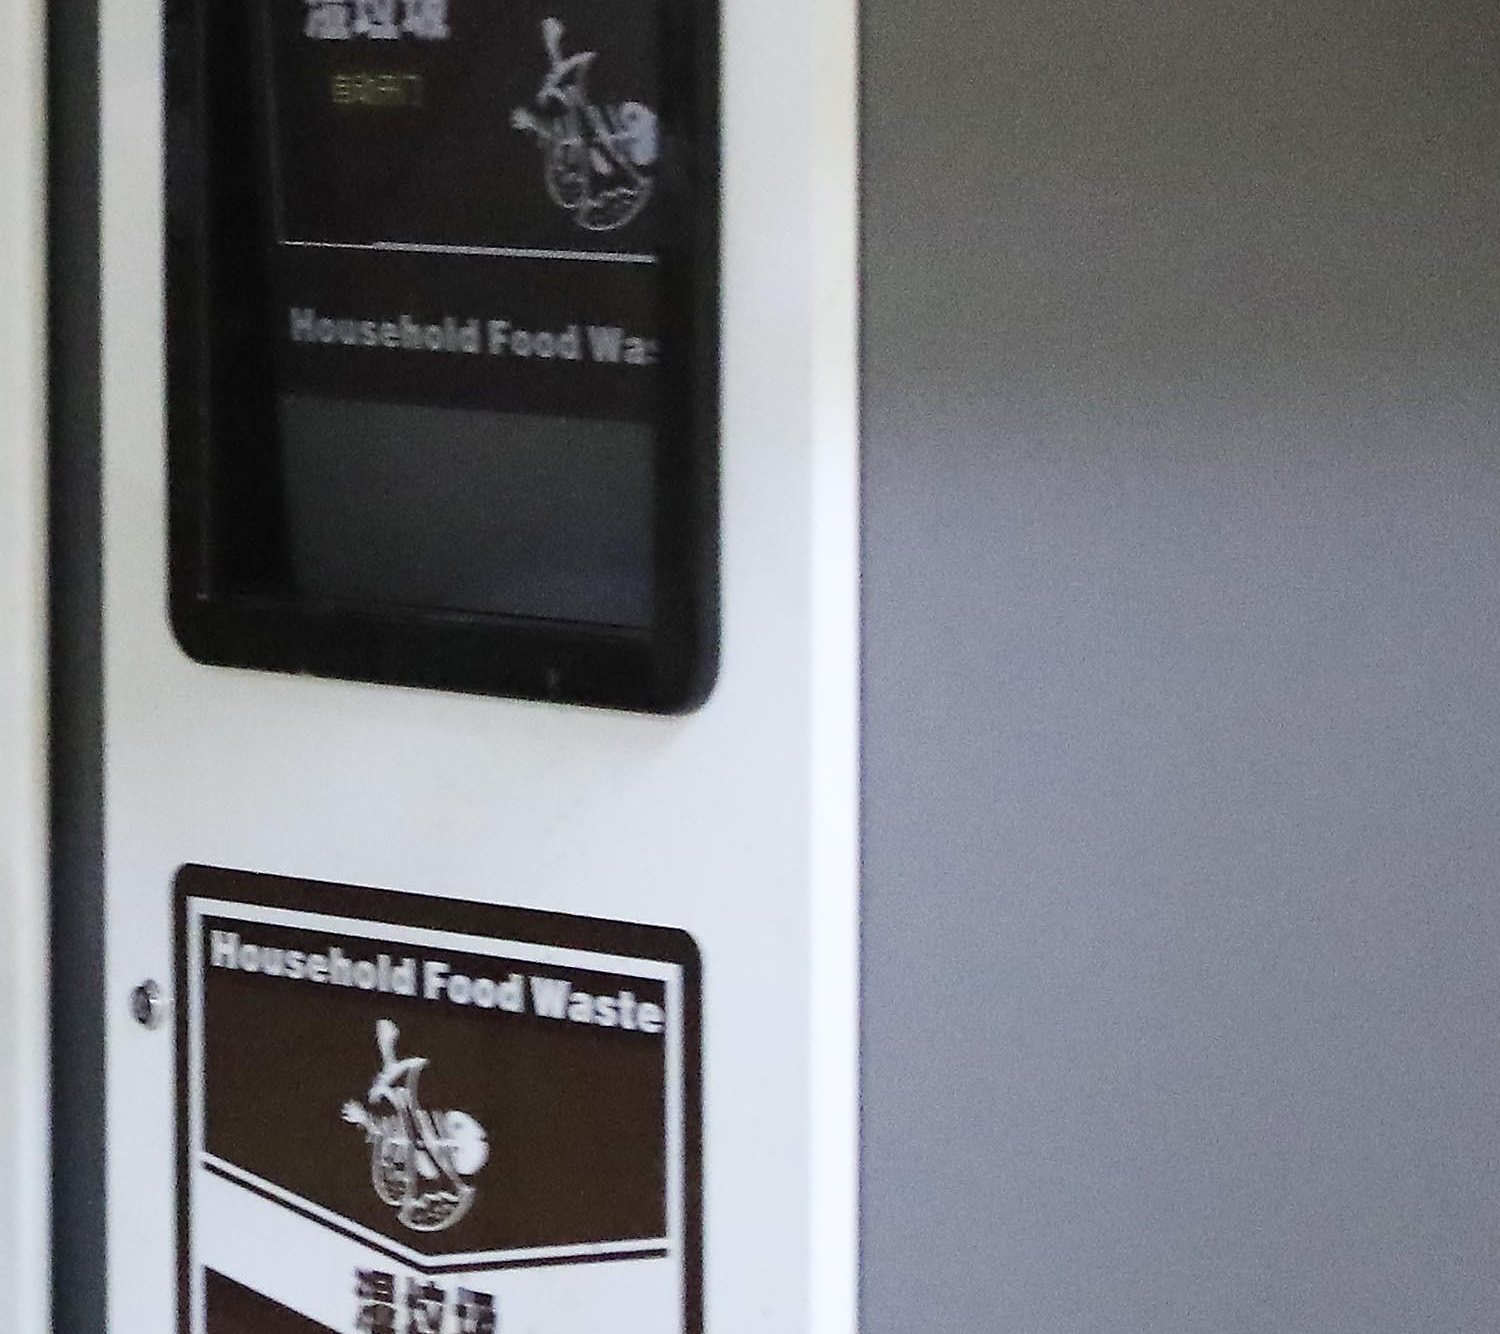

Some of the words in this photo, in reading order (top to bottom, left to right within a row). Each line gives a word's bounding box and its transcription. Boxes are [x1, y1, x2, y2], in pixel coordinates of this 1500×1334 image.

[290, 308, 480, 354] Household
[487, 320, 581, 361] Food
[210, 930, 417, 996] Household
[423, 961, 525, 1013] Food
[530, 975, 665, 1034] Waste
